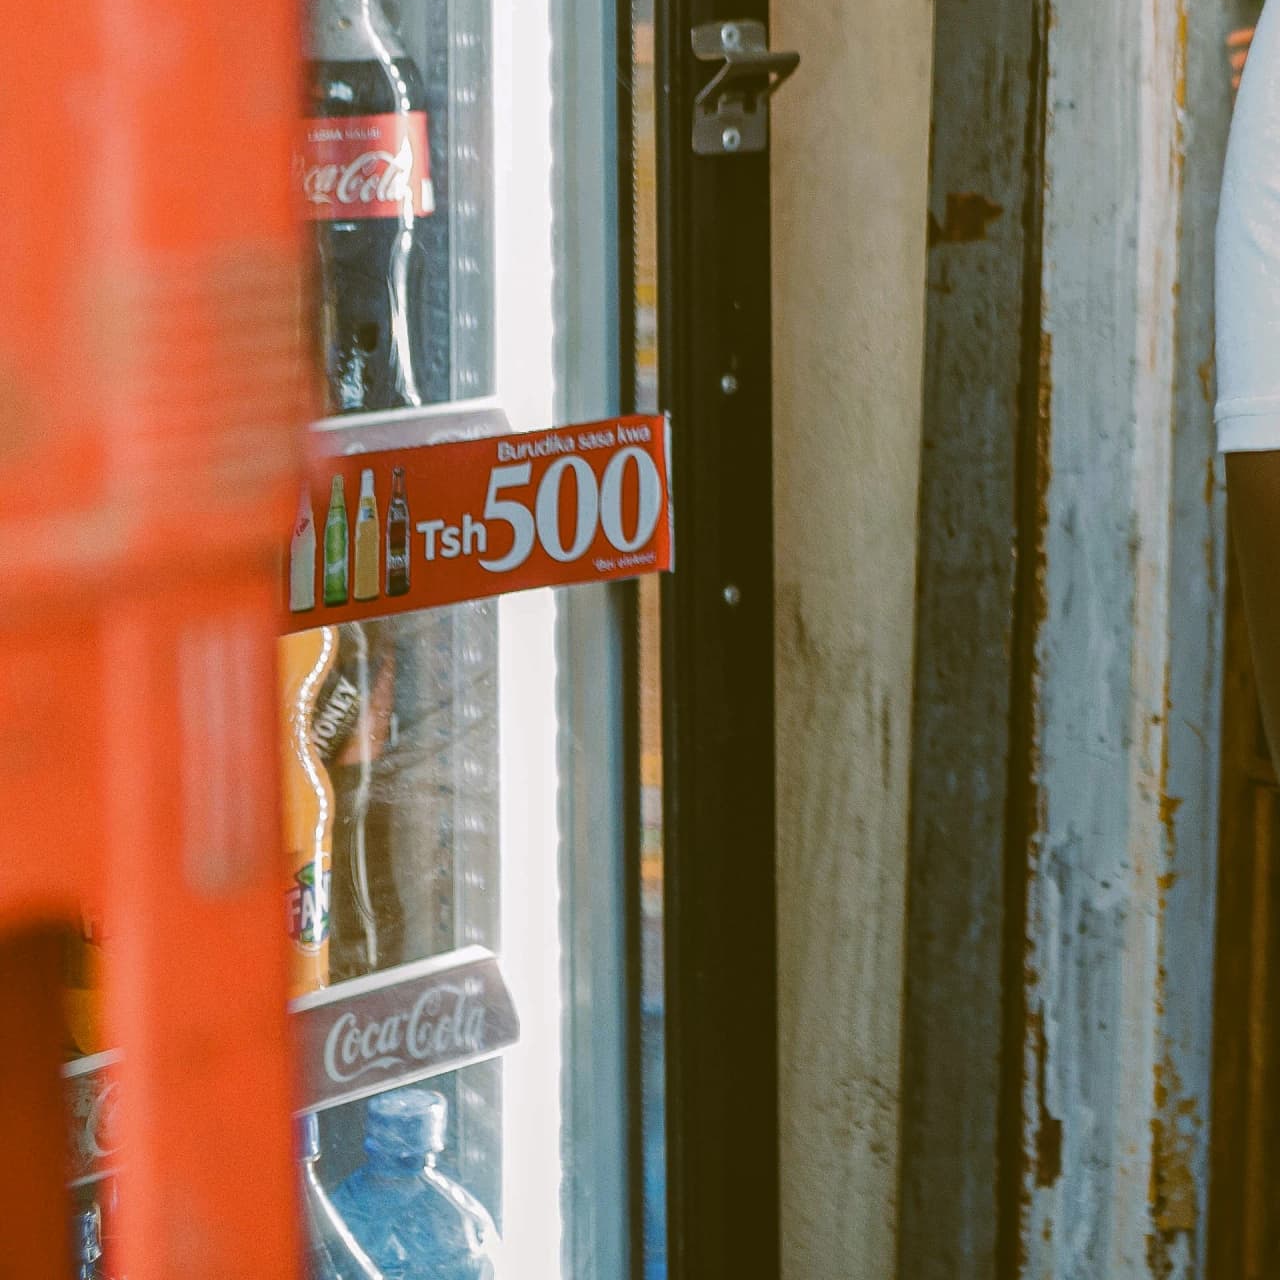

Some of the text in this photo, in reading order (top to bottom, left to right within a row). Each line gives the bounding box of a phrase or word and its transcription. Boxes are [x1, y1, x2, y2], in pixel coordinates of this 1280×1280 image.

[416, 446, 662, 572] Tsh 500
[313, 674, 359, 760] TONEY
[323, 983, 487, 1083] Coca-Cola
